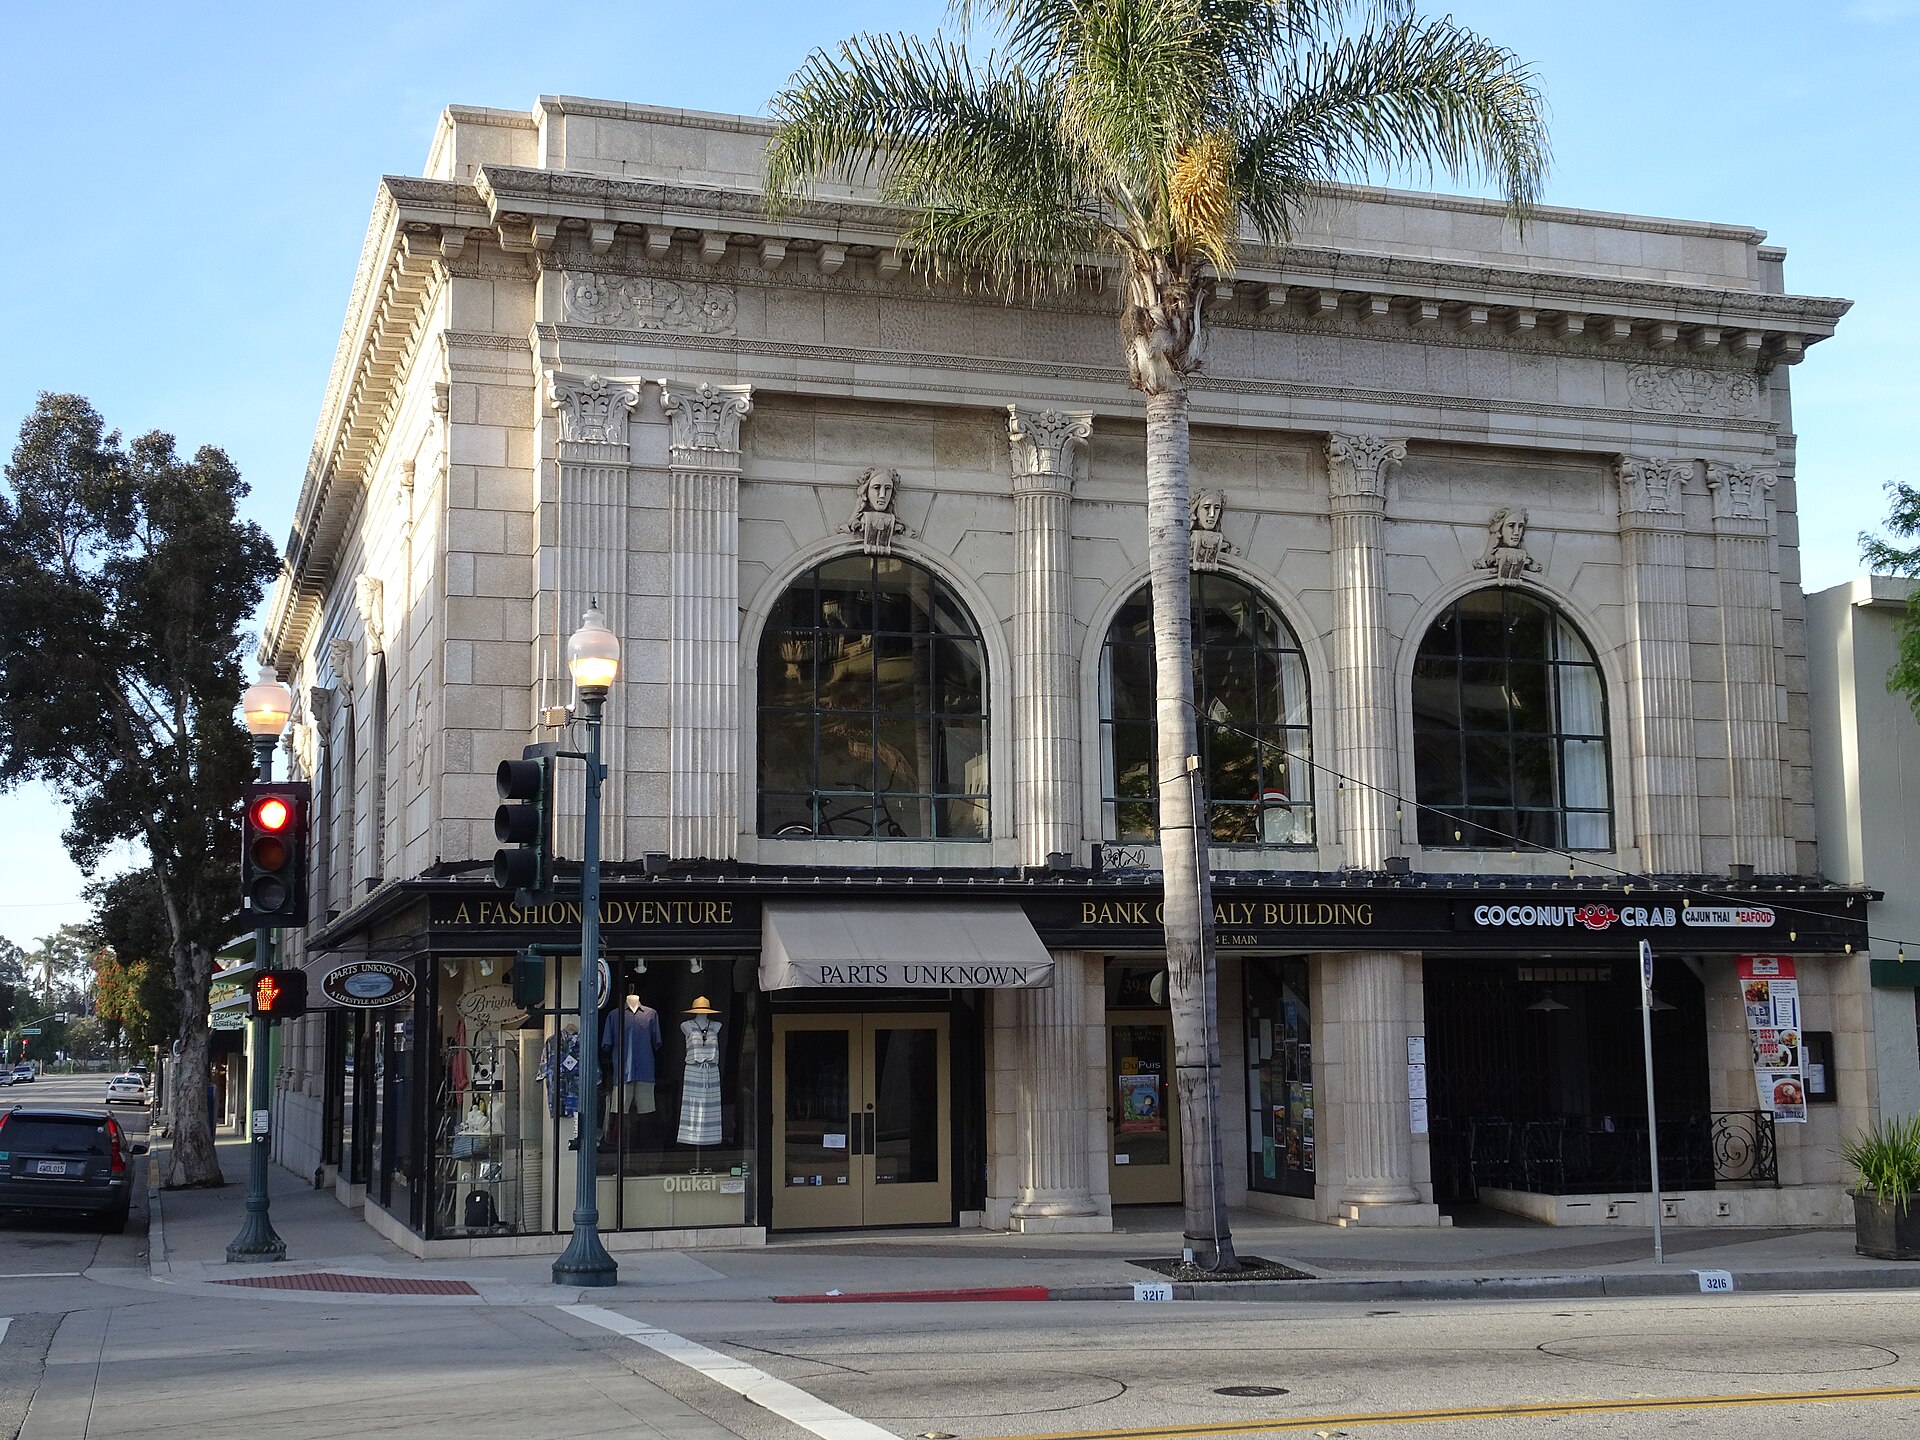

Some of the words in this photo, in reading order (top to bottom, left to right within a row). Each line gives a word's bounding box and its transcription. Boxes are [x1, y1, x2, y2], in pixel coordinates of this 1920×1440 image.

[479, 901, 582, 925] FASHION
[1081, 902, 1150, 925] BANK
[1213, 903, 1257, 924] ALY
[1263, 903, 1373, 926] BUILDING
[1474, 905, 1576, 927] COCONUT
[1620, 905, 1677, 927] CRAB
[1685, 911, 1710, 922] CAJUN
[1712, 911, 1730, 922] THAI
[1739, 911, 1772, 923] EAFOOD
[1232, 935, 1258, 945] MAIN
[330, 965, 358, 986] PARTS
[361, 964, 410, 986] UNKNOWN
[819, 965, 887, 984] PARTS
[902, 965, 1028, 985] UNKNOWN
[663, 1175, 717, 1192] Olukai
[1706, 1279, 1727, 1289] 3216
[1142, 1290, 1164, 1301] 3217
